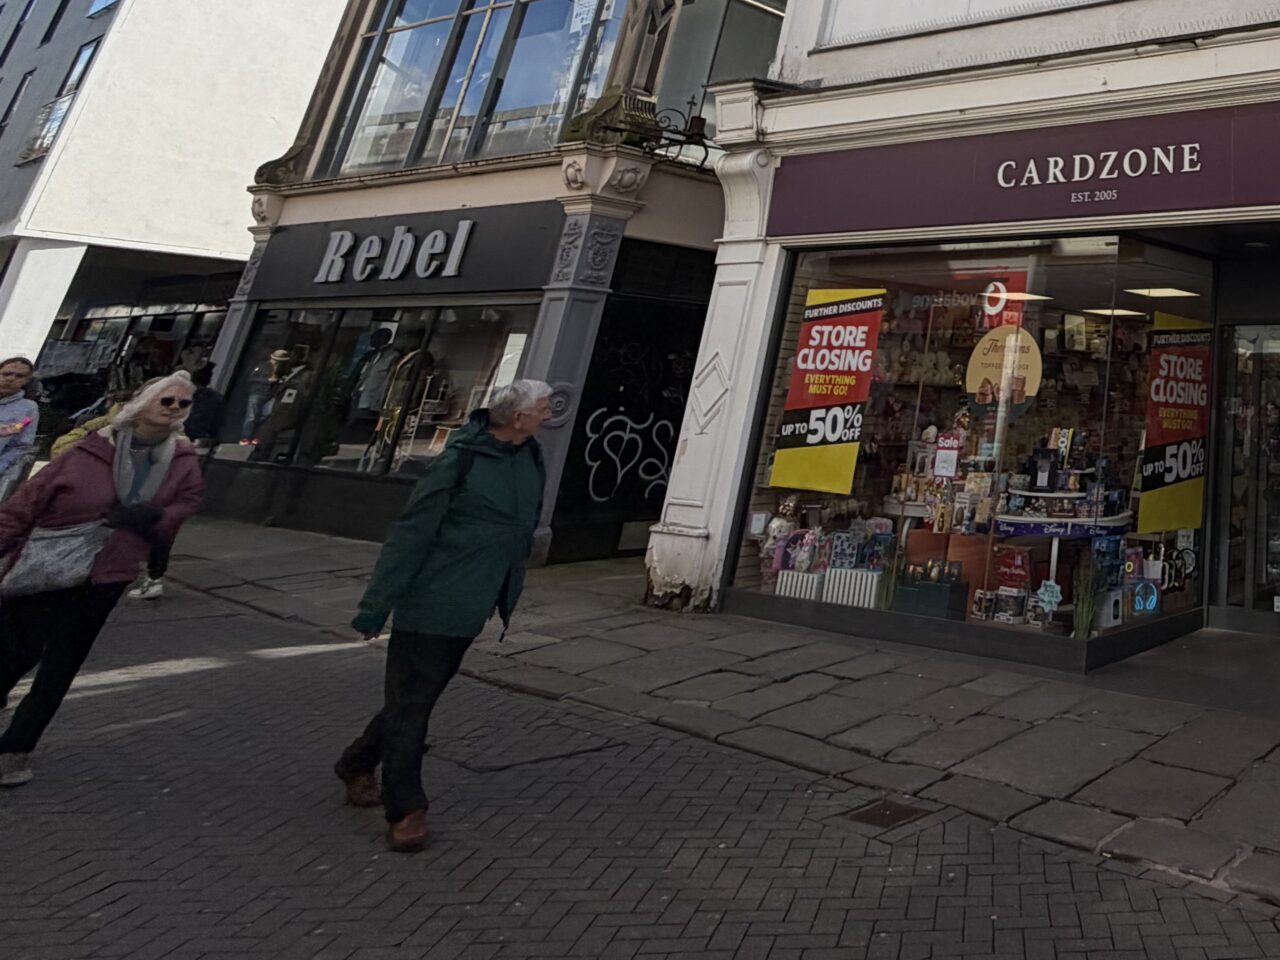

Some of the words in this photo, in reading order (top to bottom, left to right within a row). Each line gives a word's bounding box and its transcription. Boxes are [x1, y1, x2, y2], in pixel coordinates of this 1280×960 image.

[997, 143, 1202, 188] CARDZONE
[1071, 192, 1092, 203] EST.
[1094, 190, 1118, 202] 2005
[314, 219, 475, 284] Rebel
[804, 305, 838, 319] FURTHER
[839, 298, 883, 313] DISCOUNTS
[809, 325, 869, 347] STORE
[797, 348, 872, 372] CLOSING
[1159, 353, 1203, 381] STORE
[805, 374, 856, 385] EVERYTHING
[808, 385, 832, 394] MUST
[833, 386, 848, 396] GO!
[1150, 378, 1207, 406] CLOSING
[782, 424, 794, 436] UP
[795, 423, 808, 434] TO
[806, 404, 863, 444] 50%
[841, 428, 861, 441] OFF
[938, 436, 959, 448] Sale
[1142, 463, 1154, 477] UP
[1155, 461, 1165, 474] TO
[1164, 439, 1204, 483] 50%
[1190, 462, 1204, 476] OFF
